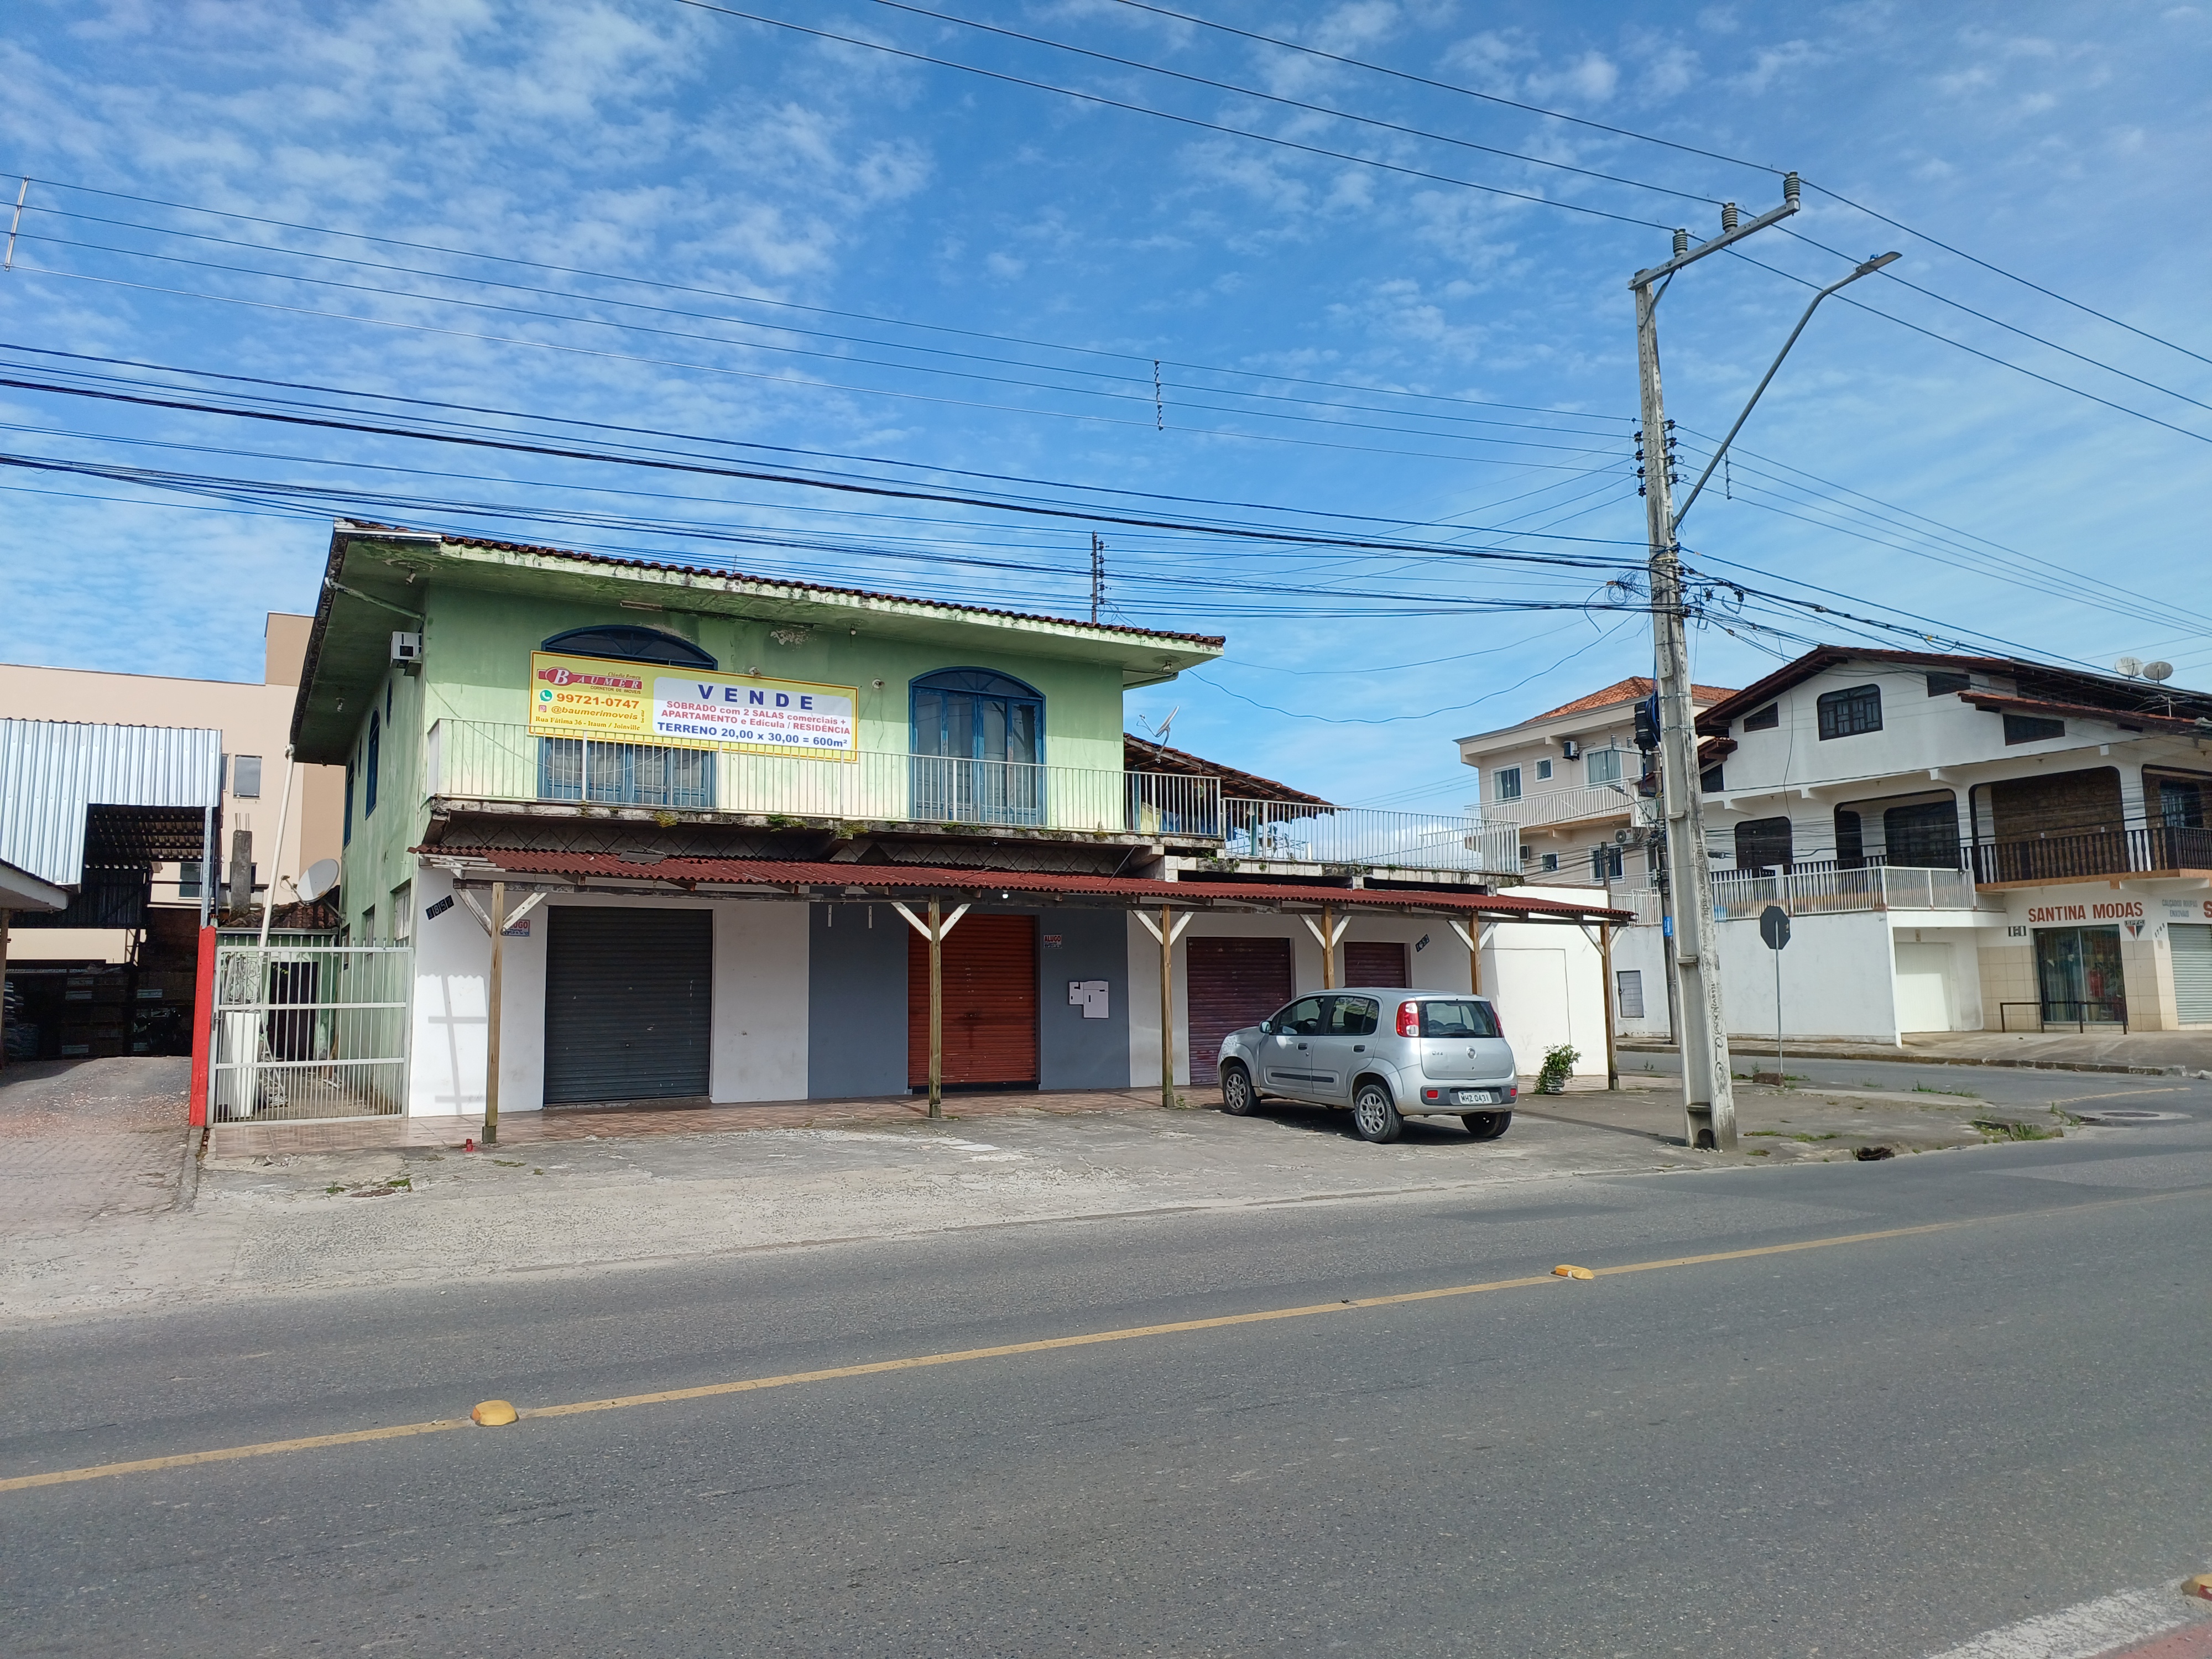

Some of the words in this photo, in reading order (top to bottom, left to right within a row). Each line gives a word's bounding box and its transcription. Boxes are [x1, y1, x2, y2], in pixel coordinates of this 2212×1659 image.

[553, 669, 639, 688] BAUMER
[556, 693, 640, 709] 99721-0747
[698, 684, 813, 711] VENDE
[550, 717, 573, 725] Fátima
[551, 706, 638, 720] @baumerimoveis
[661, 709, 738, 724] APARTAMENTO
[750, 718, 785, 728] Edícula
[793, 722, 851, 735] RESIDÊNCIA
[666, 701, 717, 712] SOBRADO
[752, 709, 784, 719] SALAS
[787, 714, 838, 725] comerciais
[657, 722, 717, 736] TERRENO
[721, 728, 753, 740] 20,00
[768, 732, 799, 744] 30,00
[813, 737, 848, 747] 600m²
[427, 896, 453, 919] 1852
[2028, 905, 2086, 922] SANTINA
[2092, 901, 2143, 919] MODAS
